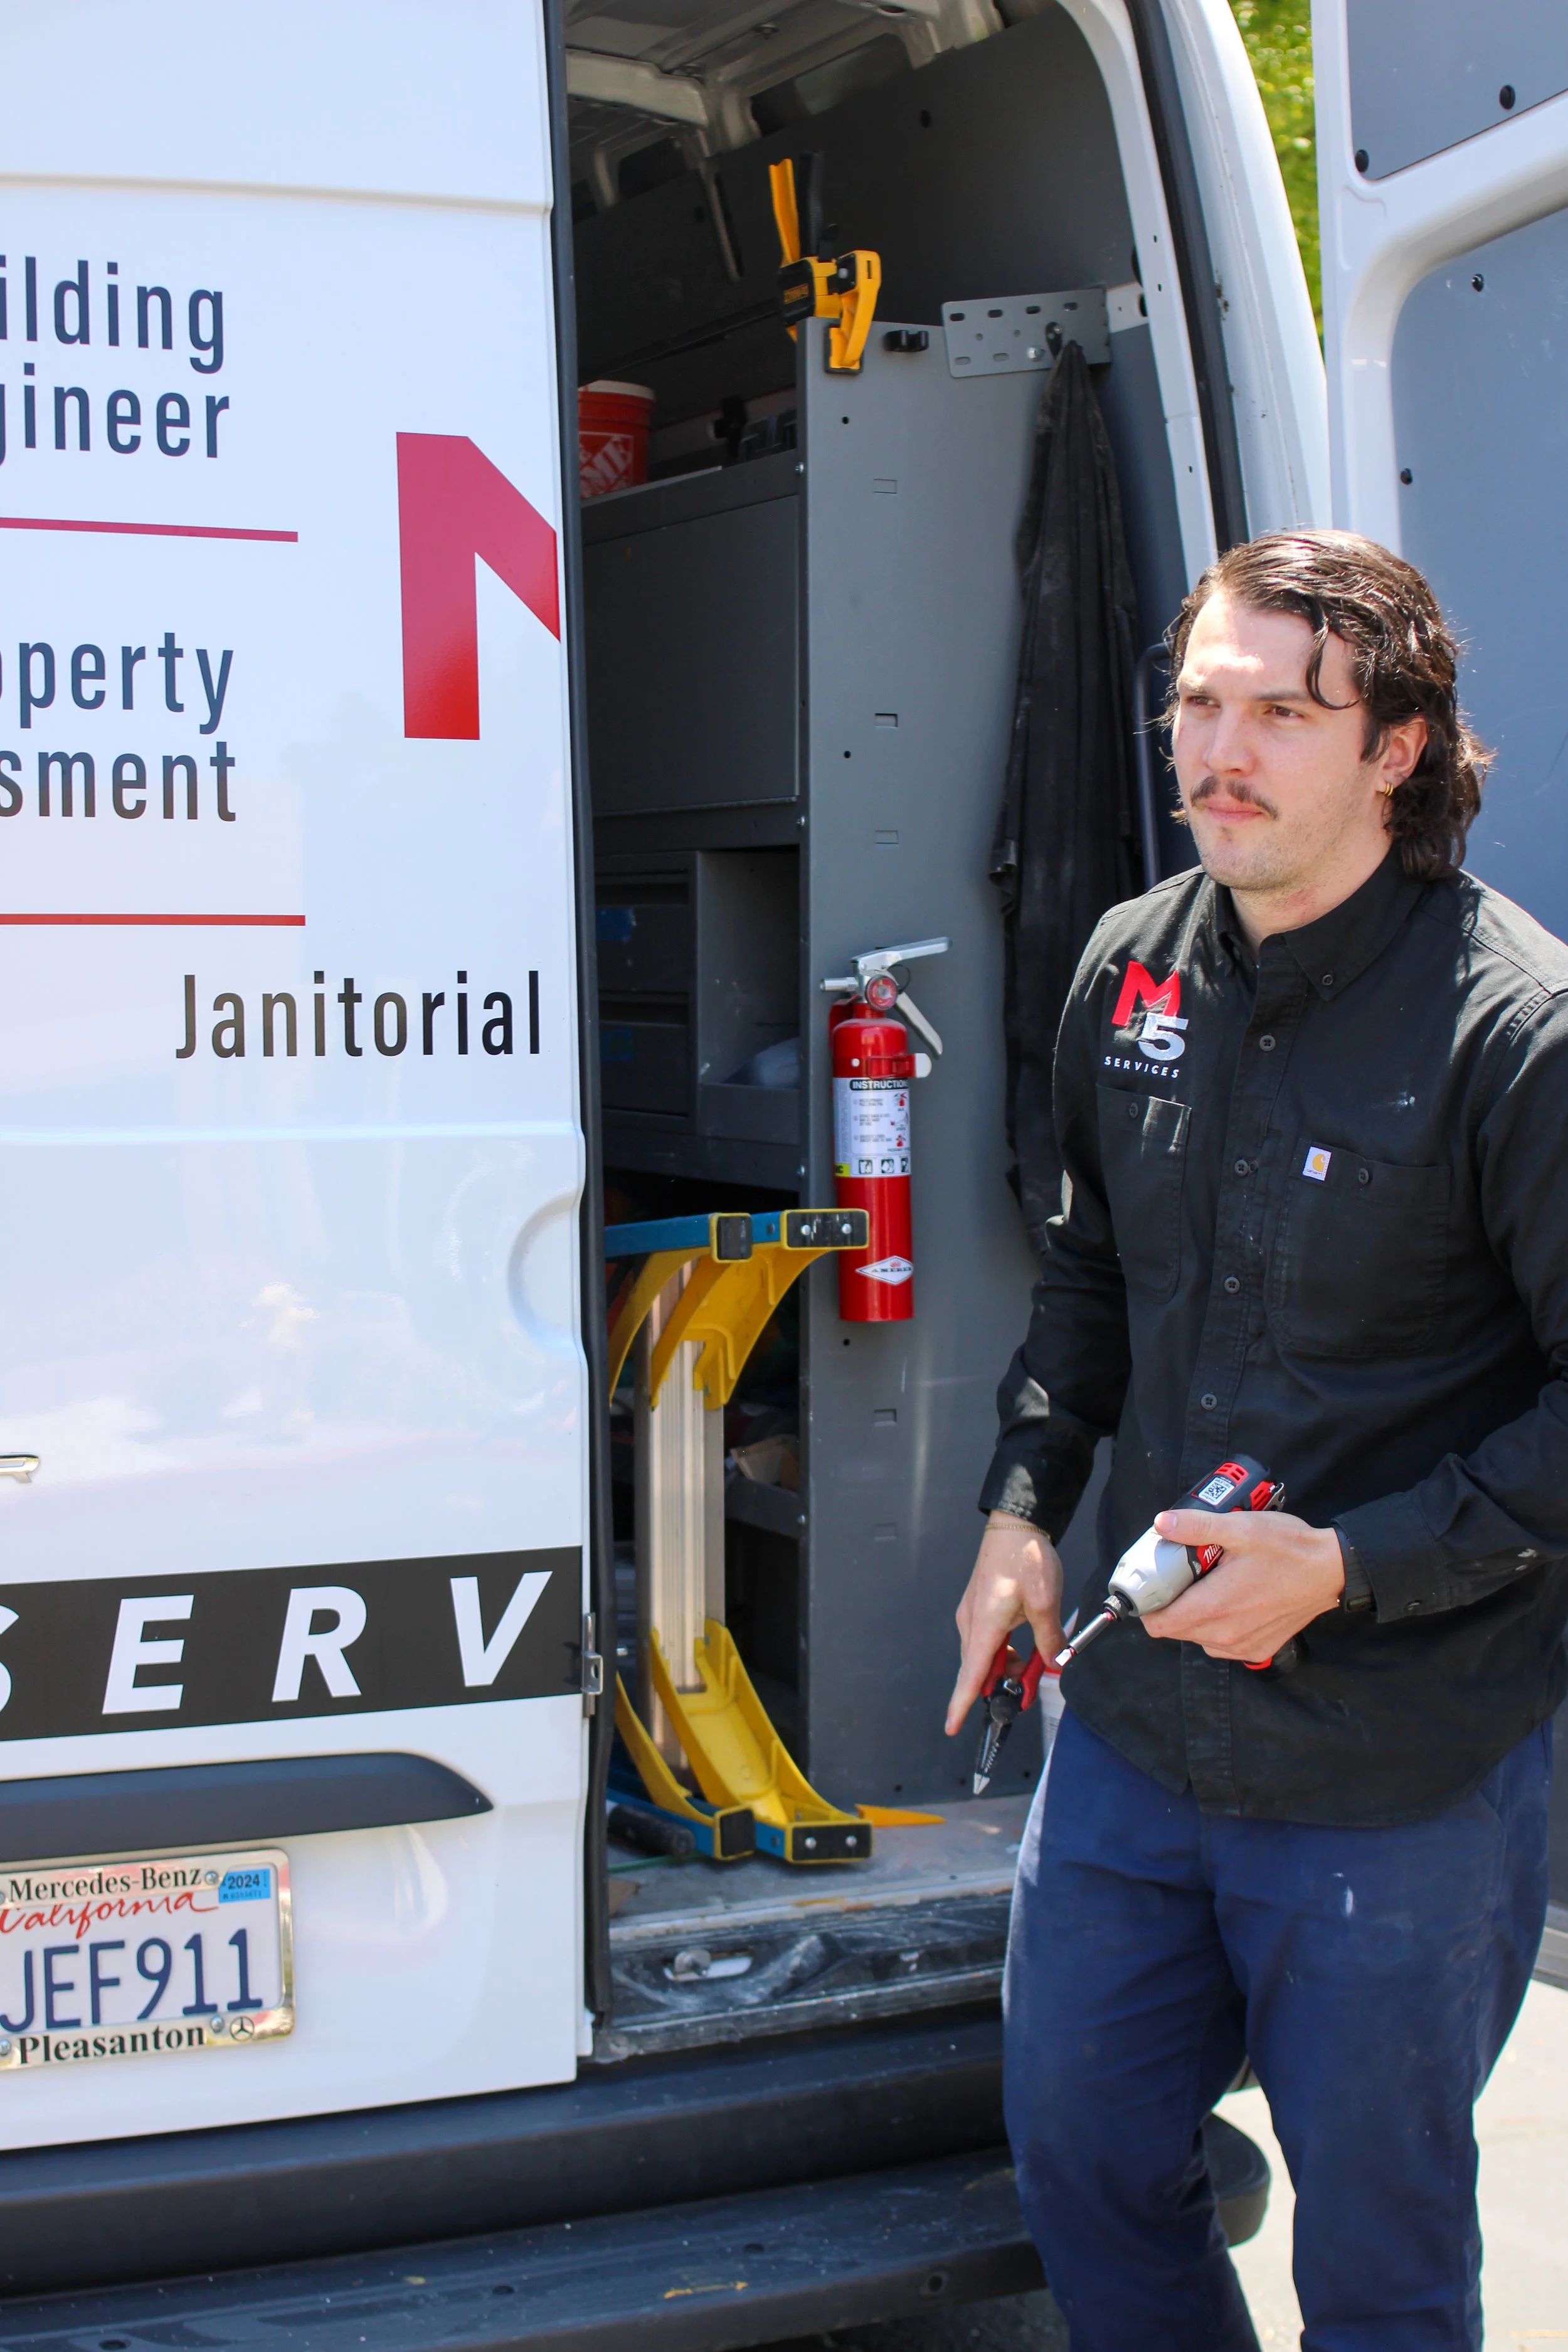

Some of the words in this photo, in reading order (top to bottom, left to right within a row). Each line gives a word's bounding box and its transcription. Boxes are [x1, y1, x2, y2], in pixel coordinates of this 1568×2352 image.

[0, 255, 225, 374] ilding
[0, 362, 230, 466] ineer
[0, 632, 235, 735] perty
[0, 741, 236, 822] sment
[176, 970, 541, 1059] Janitorial
[1104, 1055, 1180, 1079] SERVICES
[0, 1891, 219, 1939] California
[9, 1866, 202, 1903] Mercedes-Benz
[228, 1873, 260, 1890] 2024
[0, 1928, 263, 2033] JEF911
[19, 2023, 207, 2064] Pleasanton
